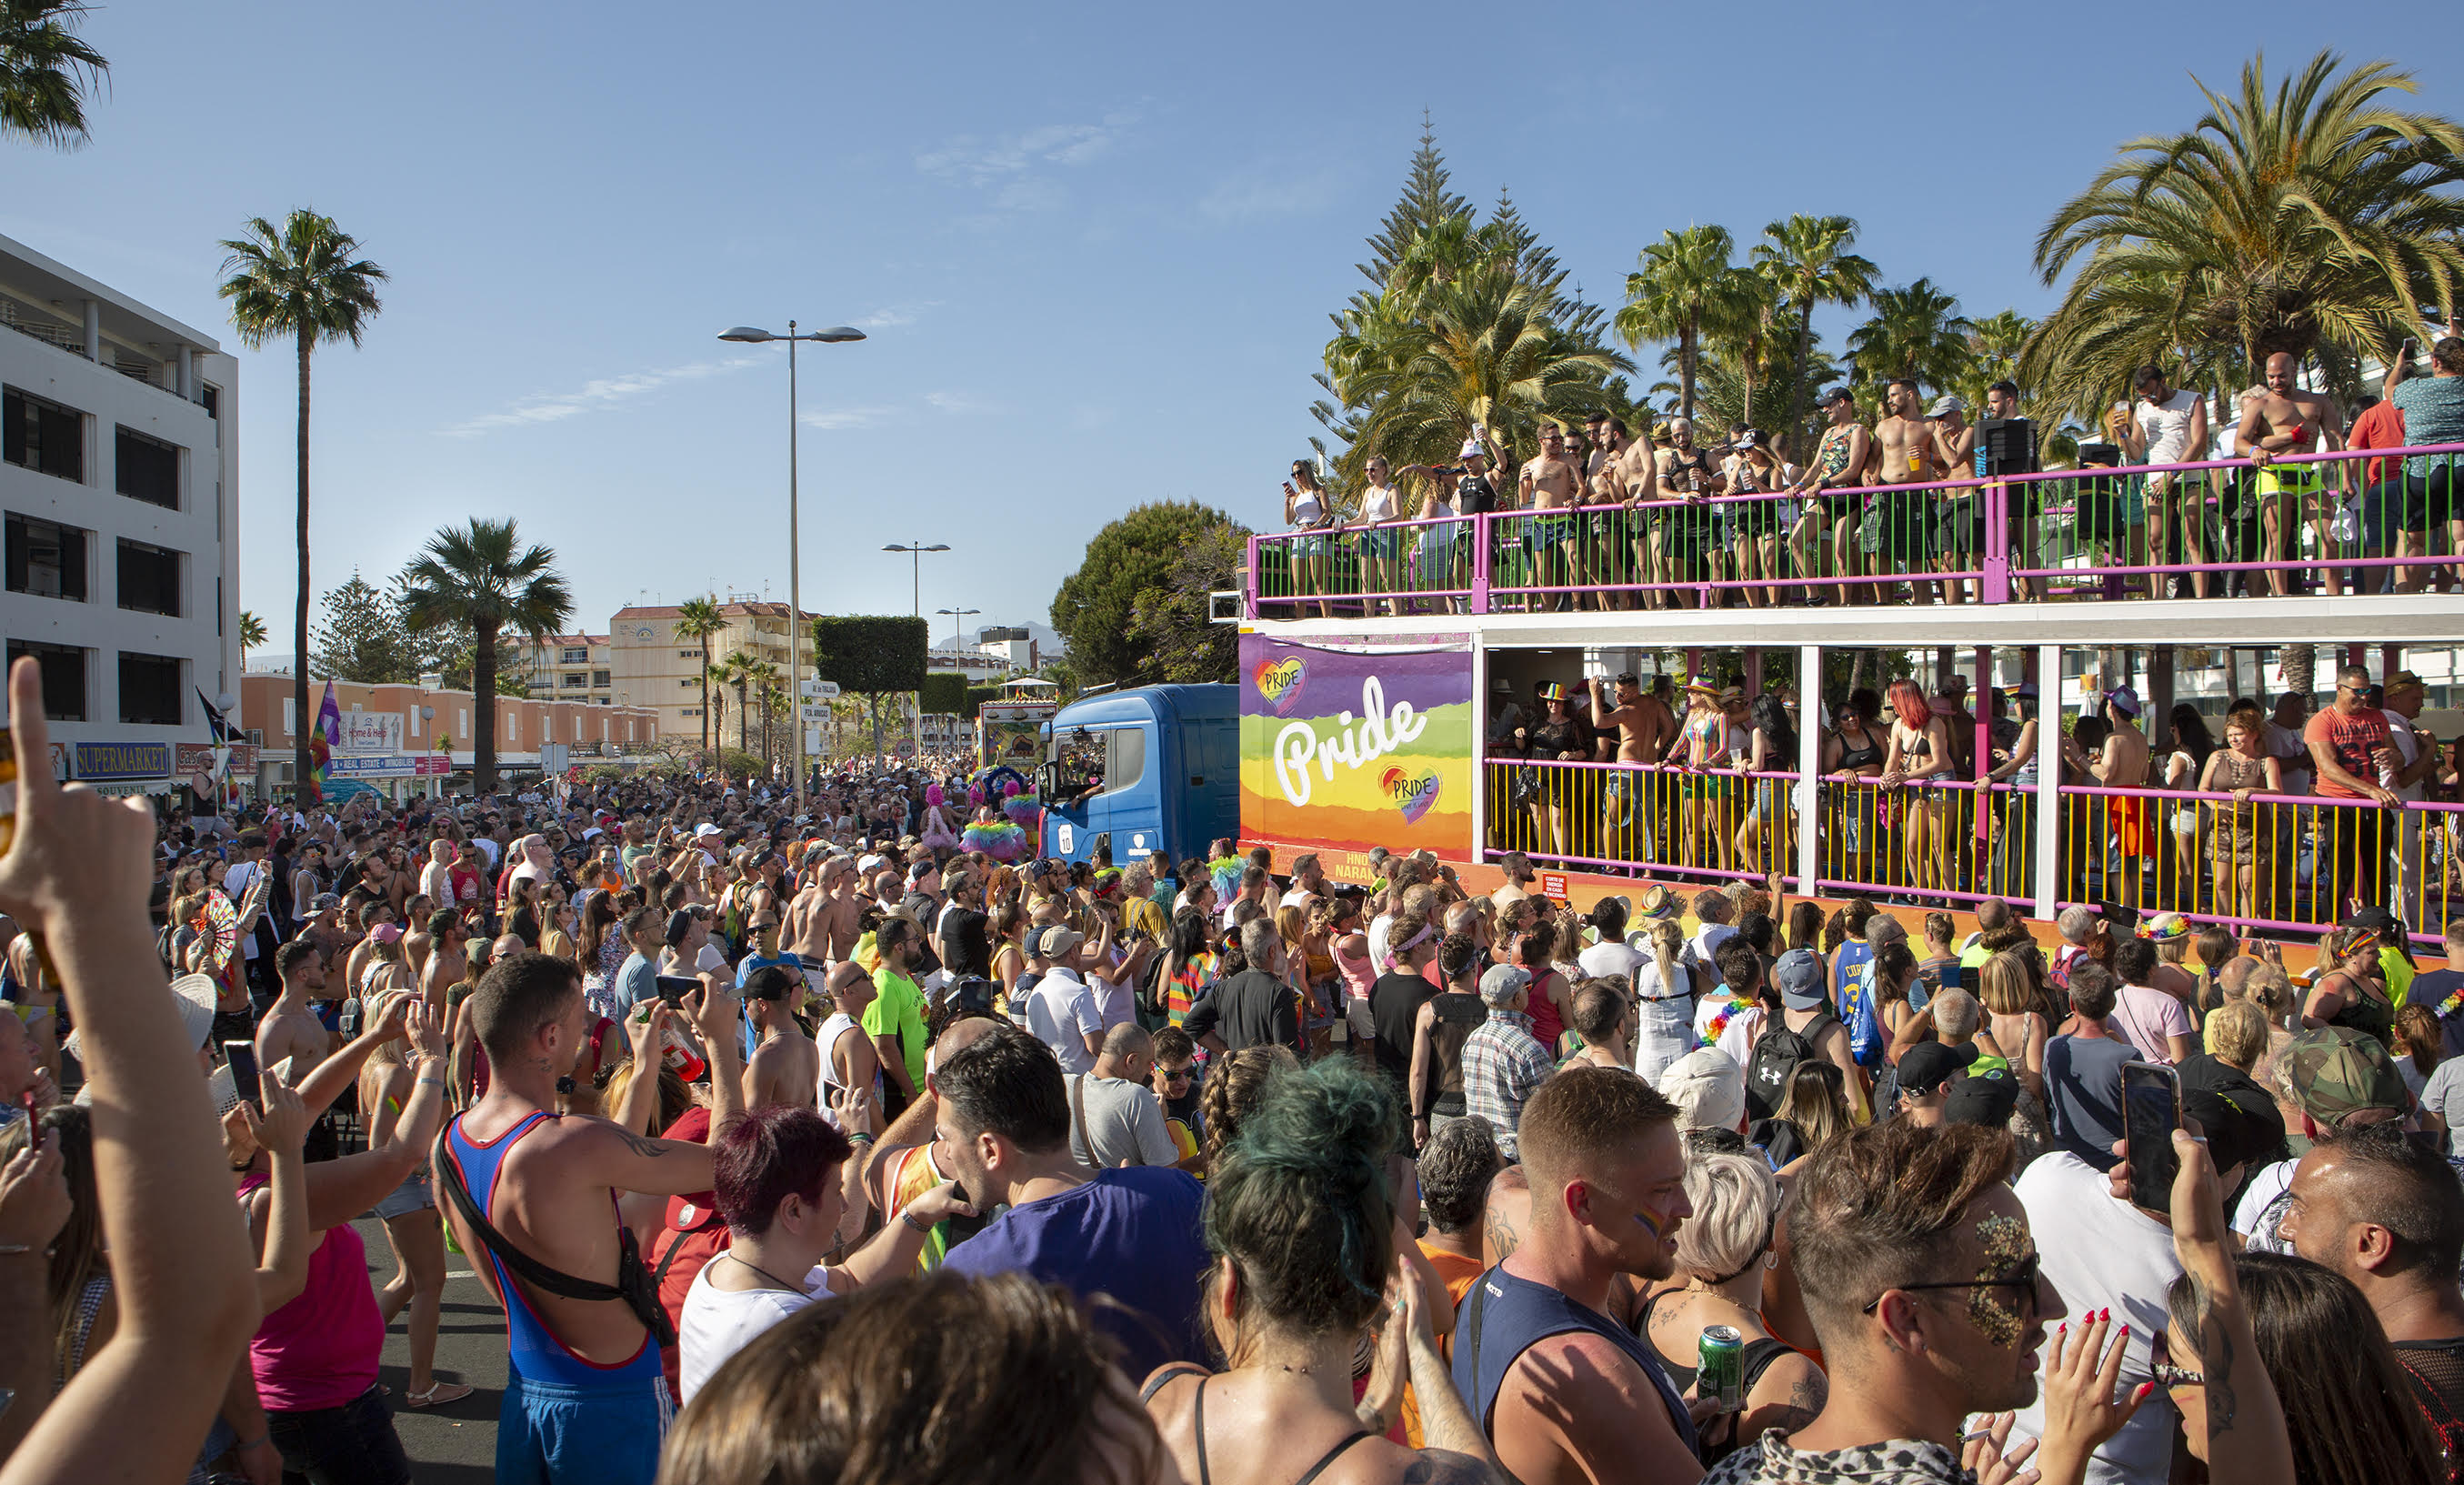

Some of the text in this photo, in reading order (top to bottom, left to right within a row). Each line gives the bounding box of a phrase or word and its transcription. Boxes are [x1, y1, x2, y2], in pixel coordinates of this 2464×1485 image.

[1265, 669, 1300, 691] PRIDE
[814, 709, 828, 717] ARUCAS
[348, 728, 387, 738] Home & Help
[1275, 675, 1427, 807] Pride
[77, 747, 165, 773] SUPERMARKET
[344, 759, 359, 769] REAL
[360, 759, 380, 768] ESTATE
[96, 785, 146, 795] SOUVENIR
[1393, 778, 1433, 799] PRIDE
[1062, 838, 1071, 851] 10
